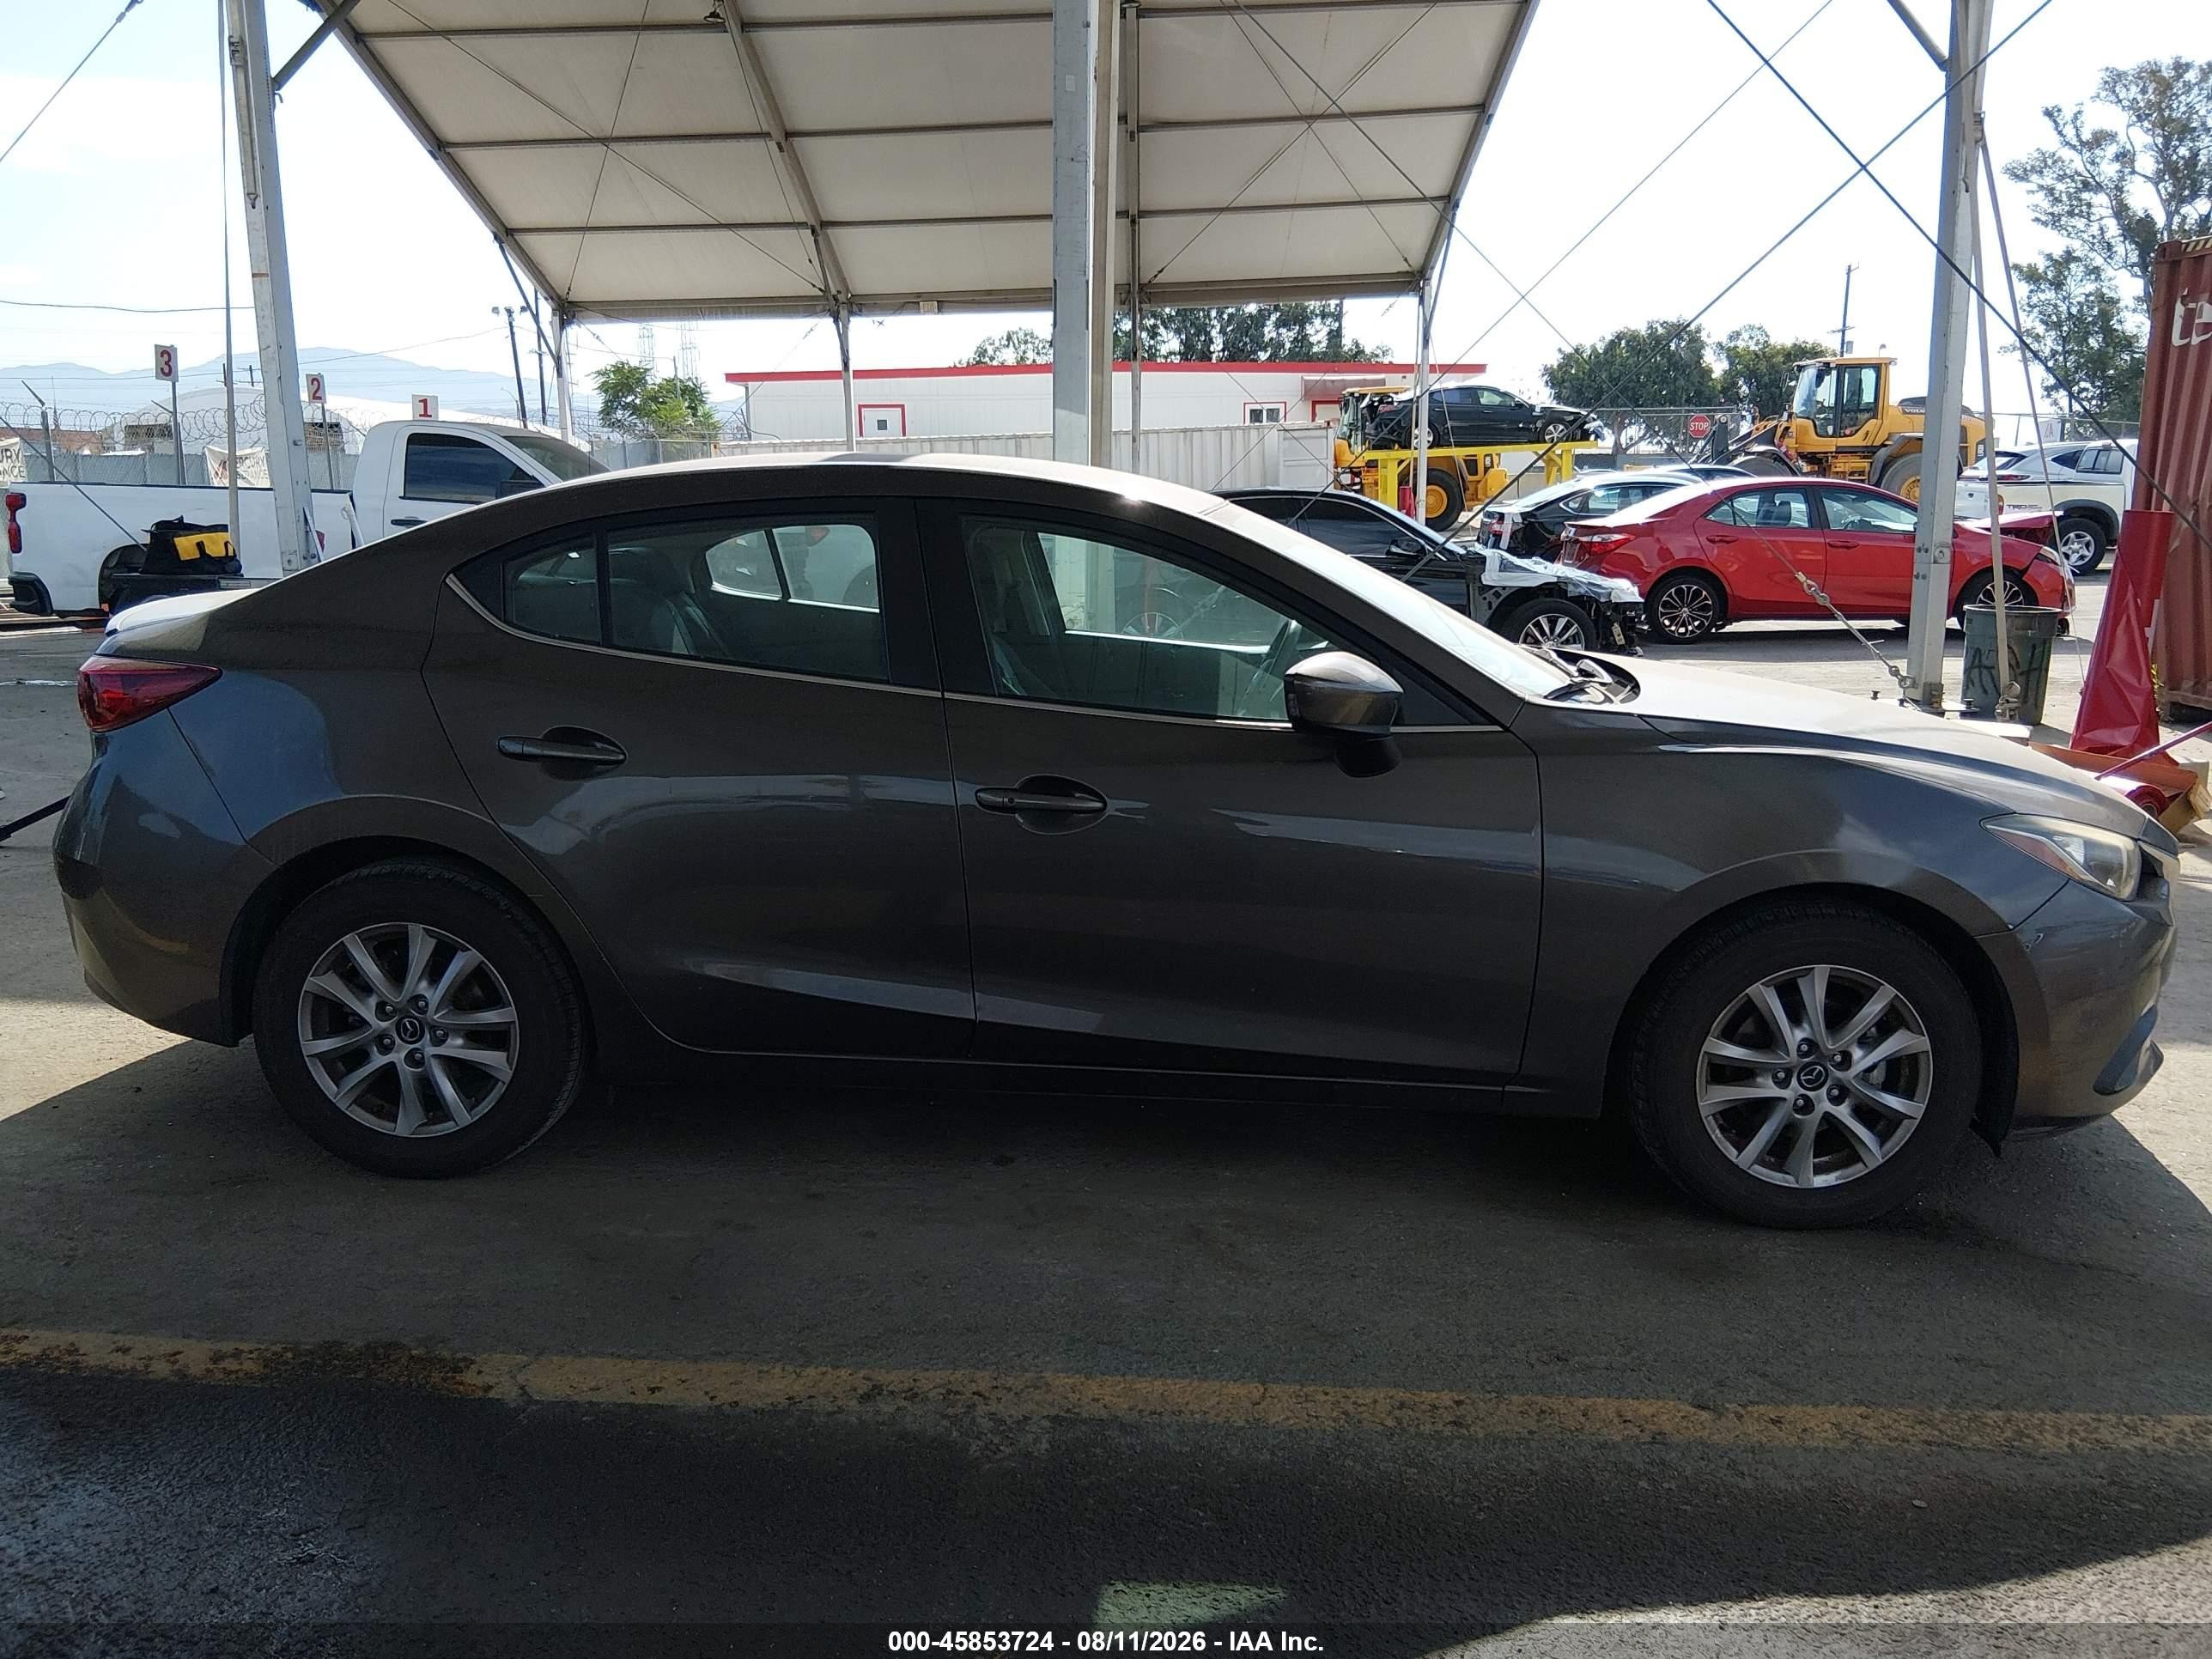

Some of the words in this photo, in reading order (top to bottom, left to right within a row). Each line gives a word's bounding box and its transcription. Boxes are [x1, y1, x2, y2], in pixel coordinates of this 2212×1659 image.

[160, 349, 173, 377] 3
[310, 377, 323, 400] 2
[418, 398, 433, 418] 1
[1689, 422, 1709, 431] STOP
[0, 465, 26, 480] NCE
